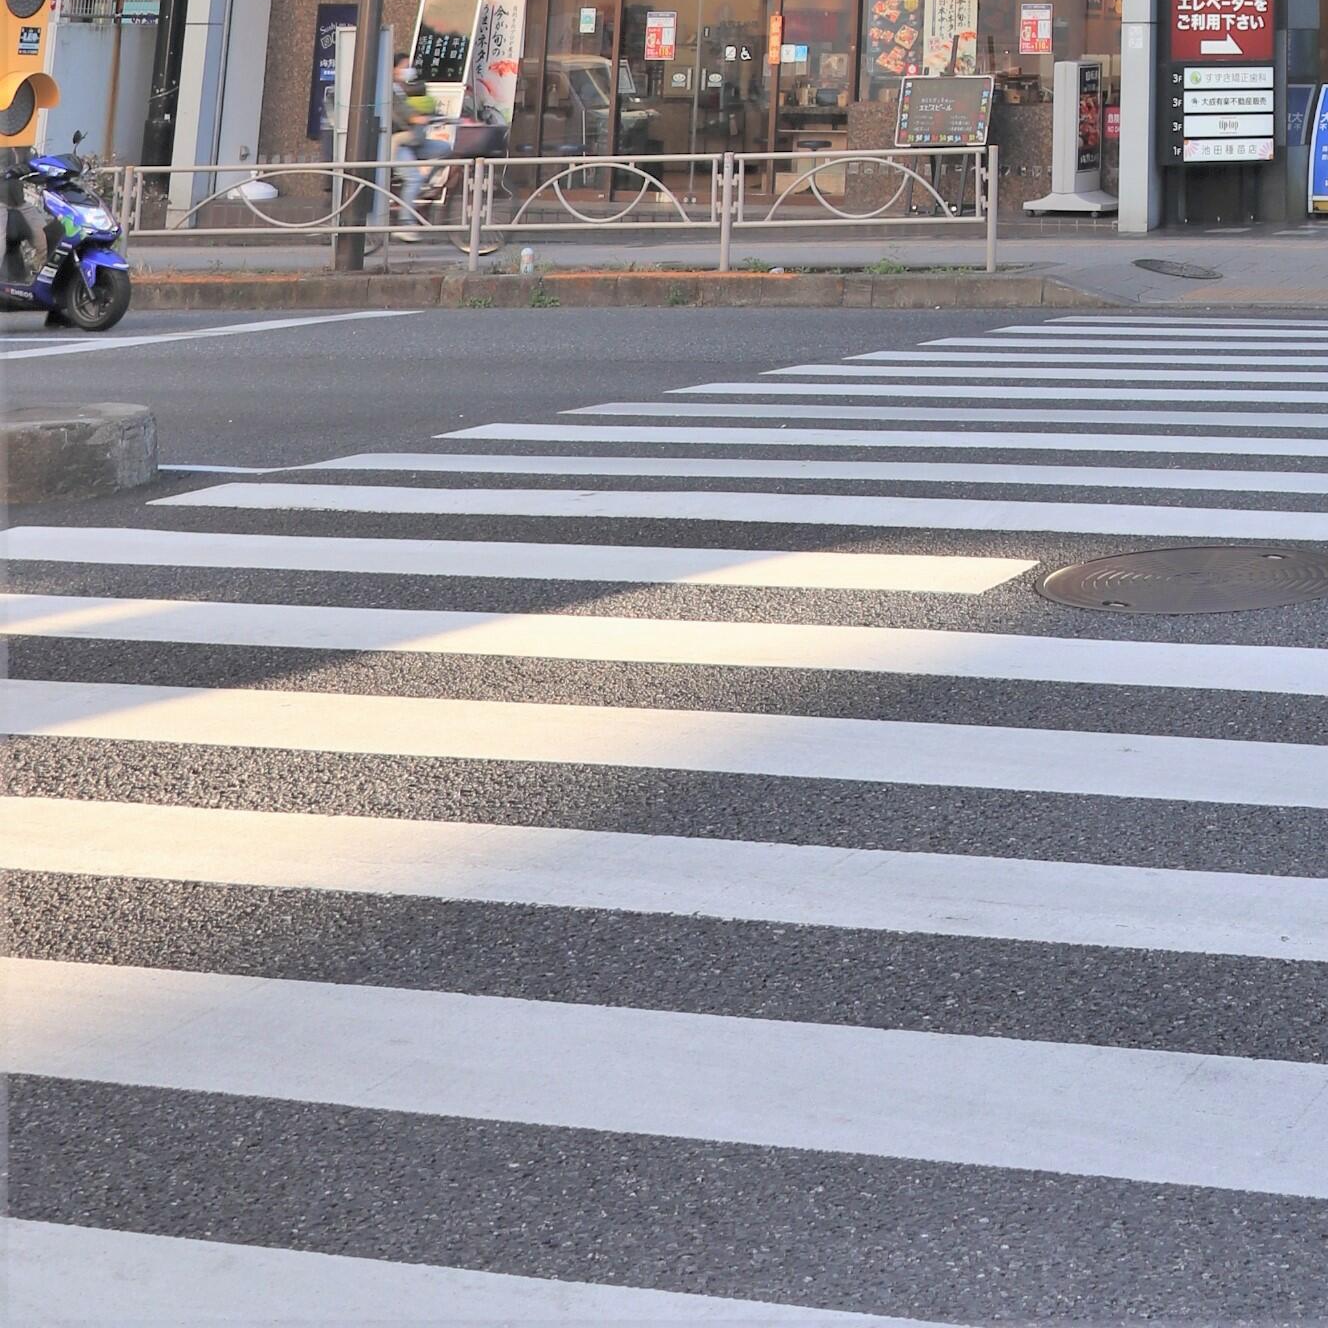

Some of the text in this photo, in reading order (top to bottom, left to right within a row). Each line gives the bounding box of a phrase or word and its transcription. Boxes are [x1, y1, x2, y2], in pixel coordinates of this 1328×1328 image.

[1176, 13, 1265, 31] ご利用下さい
[1172, 73, 1182, 83] 3F
[1172, 97, 1182, 108] 3F
[1201, 97, 1267, 106] 大成有楽不動産販売
[1172, 121, 1182, 131] 3F
[1172, 145, 1182, 156] 1F
[1201, 144, 1257, 156] 池田種苗店
